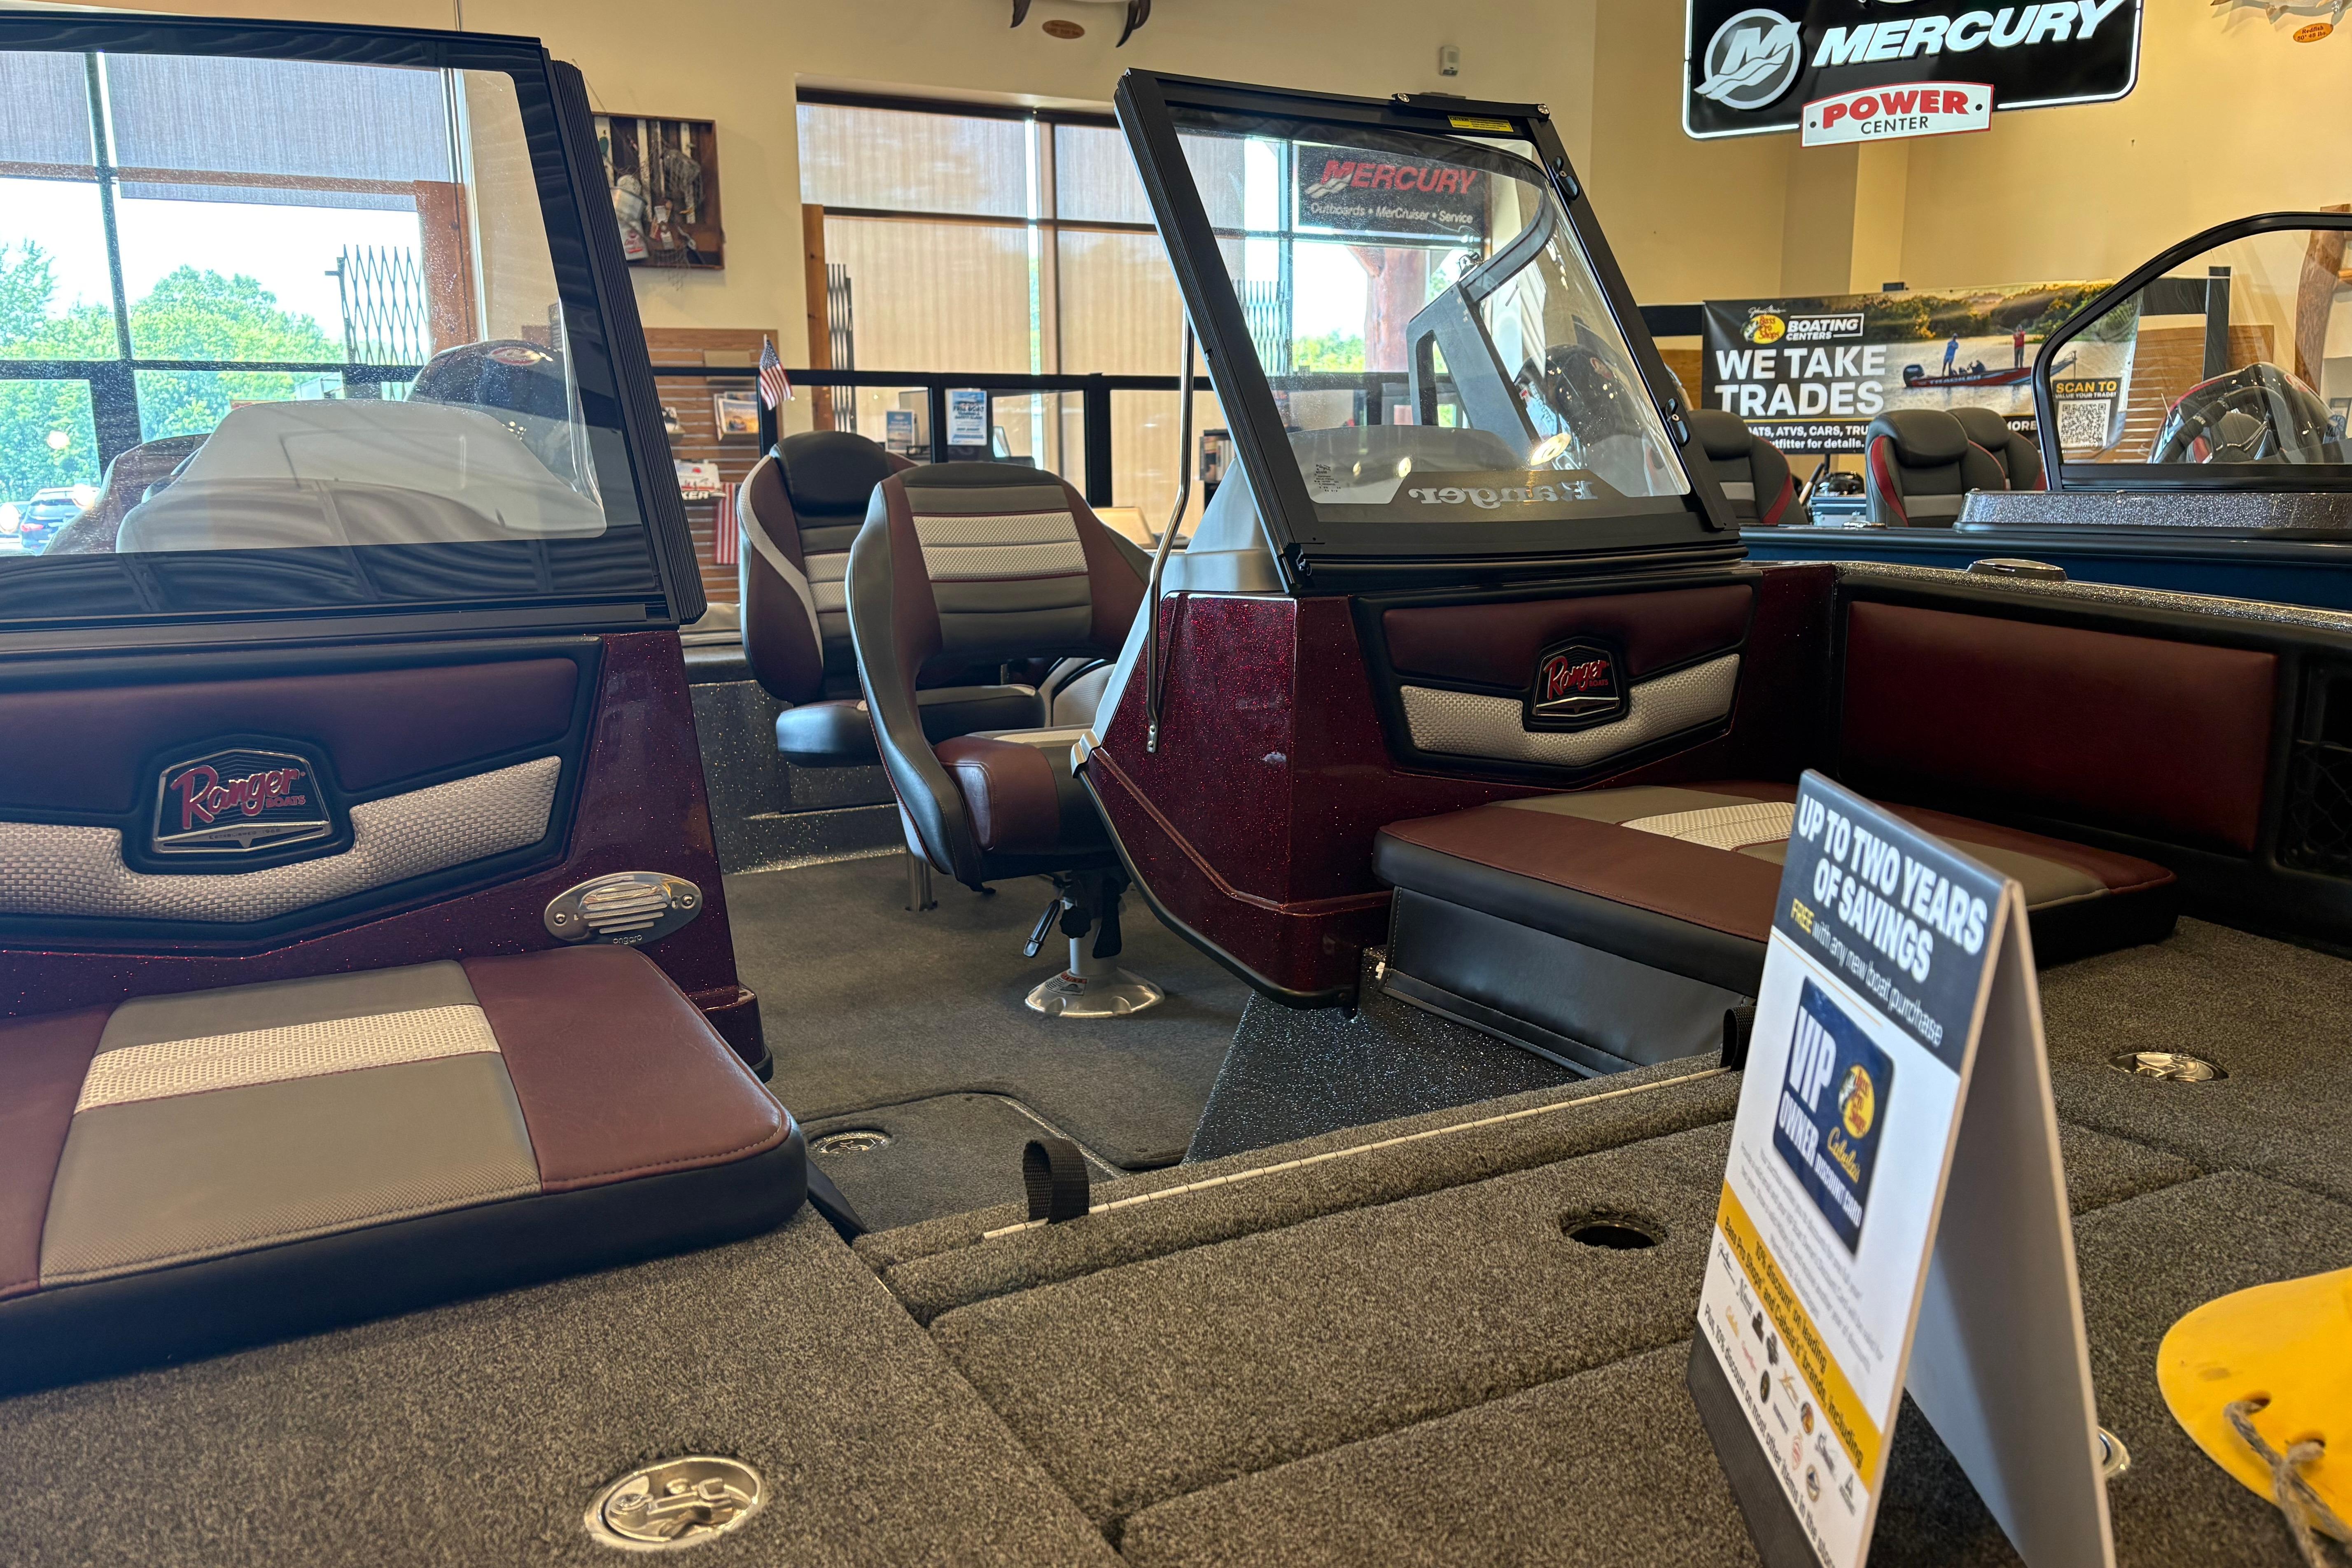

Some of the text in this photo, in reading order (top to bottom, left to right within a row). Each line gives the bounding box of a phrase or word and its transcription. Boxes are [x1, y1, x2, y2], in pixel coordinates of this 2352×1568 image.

[1811, 0, 2127, 68] MERCURY
[2302, 25, 2324, 34] Redfish
[1822, 90, 1969, 129] POWER
[1861, 115, 1930, 135] CENTER
[1320, 160, 1478, 194] MERCURY
[1311, 202, 1473, 224] Outboards MerCruiser Service
[1785, 331, 1832, 341] CENTERS
[1787, 319, 1859, 333] BOATING
[1716, 345, 1887, 380] WE TAKE
[1714, 380, 1884, 416] TRADES
[2056, 380, 2117, 393] SCAN TO
[1776, 426, 1807, 438] ATVS,
[1809, 425, 1843, 438] CARS,
[1807, 439, 1822, 449] for
[1824, 439, 1864, 449] details.
[1543, 655, 1607, 700] Ranger
[170, 765, 300, 830] Ranger
[266, 794, 306, 808] BOATS
[1797, 794, 1988, 955] UP TO TWO YEARS
[1813, 858, 1934, 984] OF SAVINGS
[613, 935, 643, 945] ongaro
[1812, 919, 1831, 950] with
[1829, 935, 1849, 968] any
[1846, 950, 1868, 982] new
[1865, 959, 1892, 1002] boat
[1888, 987, 1943, 1048] purchase
[1789, 1005, 1836, 1113] VIP
[1778, 1090, 1819, 1168] OWNER
